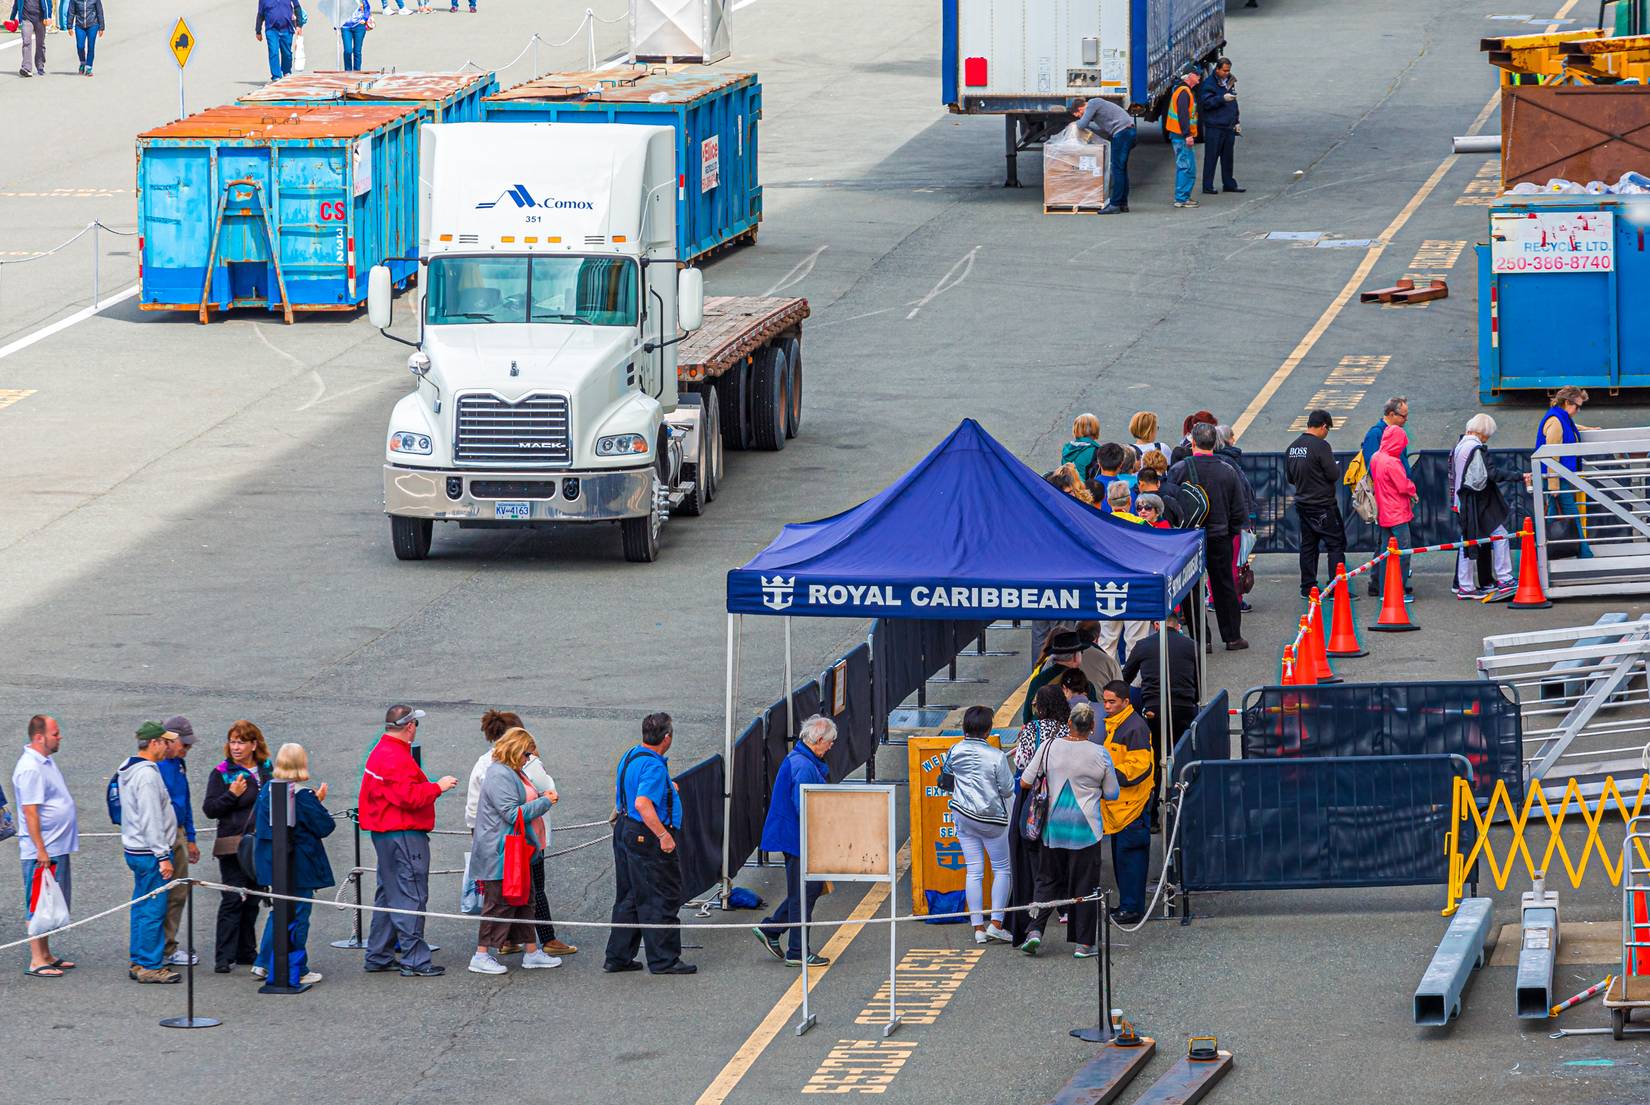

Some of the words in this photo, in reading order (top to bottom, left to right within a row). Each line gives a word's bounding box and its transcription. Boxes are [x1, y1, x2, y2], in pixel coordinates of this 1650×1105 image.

[320, 201, 345, 220] CS
[544, 197, 593, 209] Comox
[525, 215, 541, 223] 351
[336, 228, 344, 261] 332
[1586, 241, 1611, 252] LTD.
[1496, 255, 1610, 270] 250-386-8740
[1290, 447, 1307, 455] BOSS
[808, 584, 901, 606] ROYAL
[910, 586, 1080, 609] CARIBBEAN
[854, 948, 987, 1025] RESTRICTED
[801, 1039, 919, 1094] ACCESS
